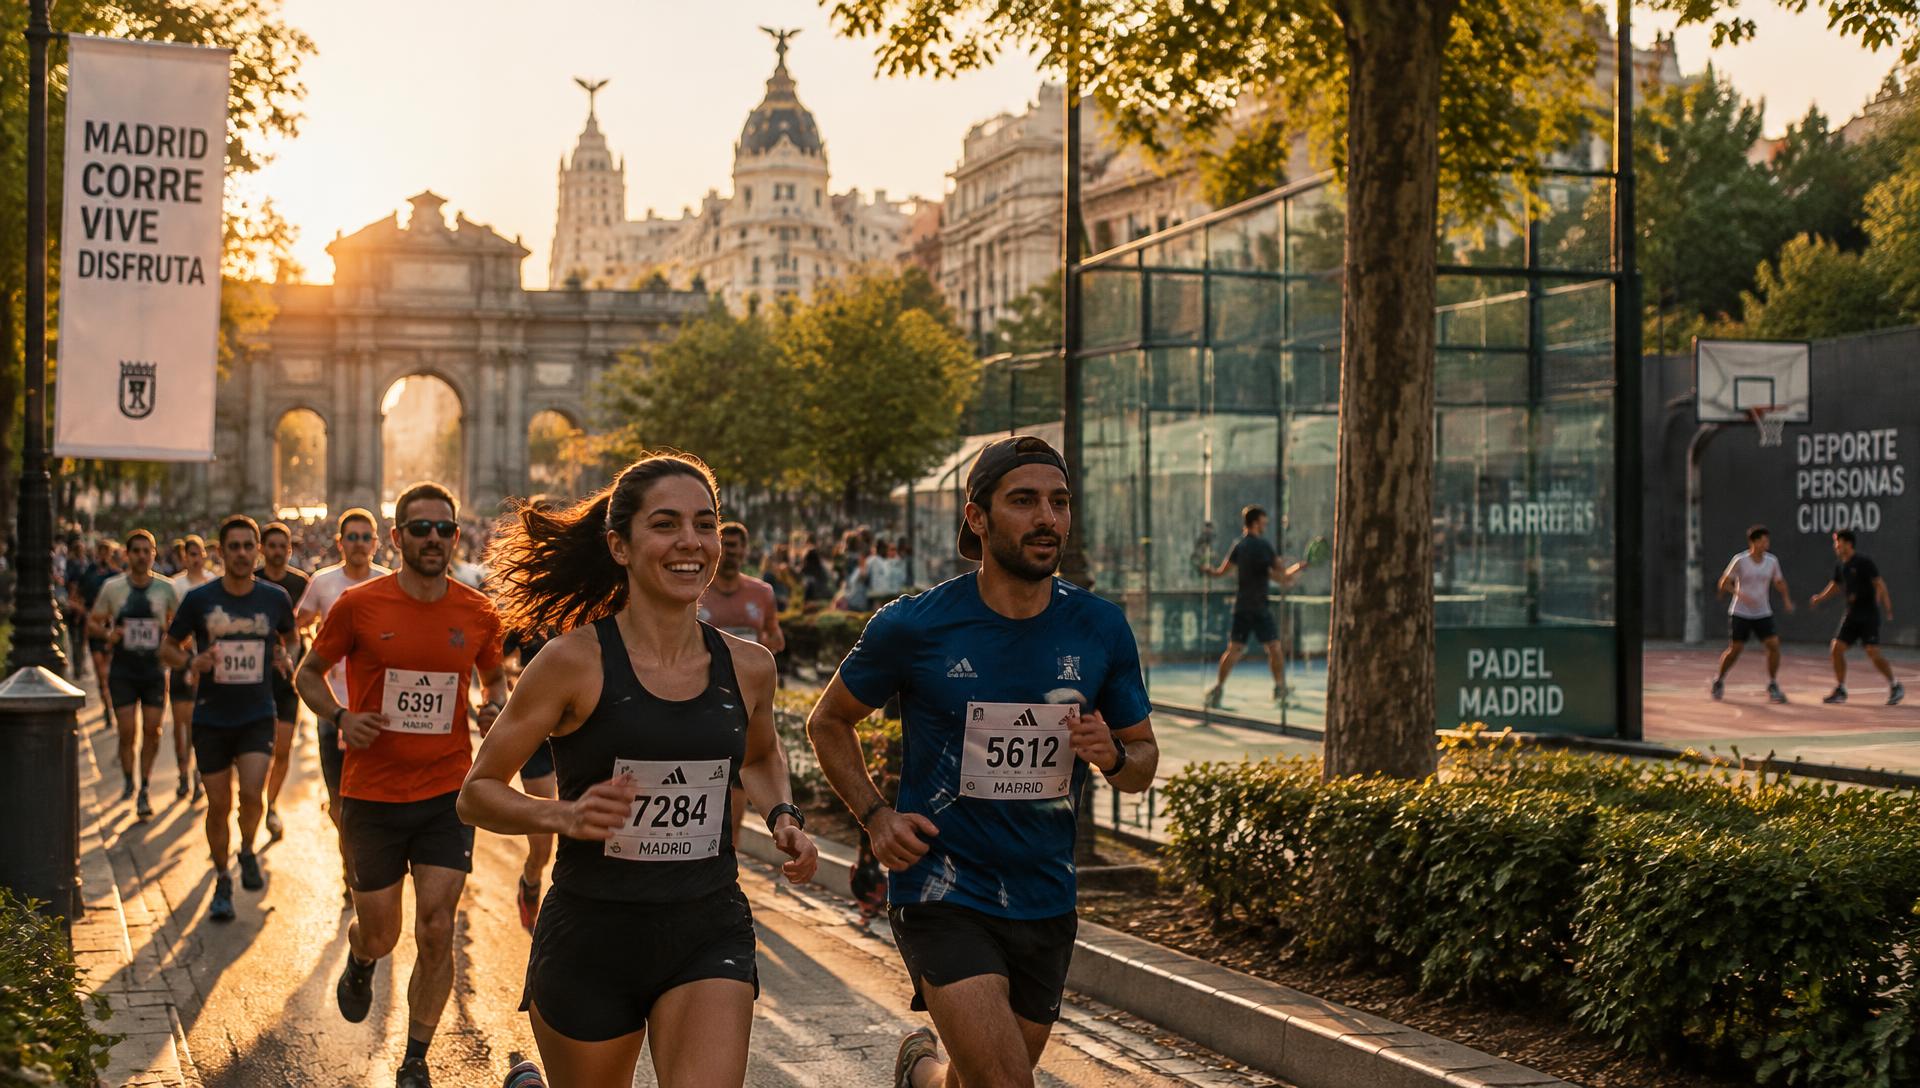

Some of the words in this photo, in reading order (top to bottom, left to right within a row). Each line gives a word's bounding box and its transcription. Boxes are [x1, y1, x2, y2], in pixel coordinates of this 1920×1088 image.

[84, 120, 208, 160] MADRID
[82, 162, 203, 203] CORRE
[81, 206, 158, 243] VIVE
[78, 250, 205, 285] DISFRUTA
[1797, 428, 1898, 465] DEPORTE
[1797, 465, 1904, 500] PERSONAS
[1797, 501, 1881, 533] CIUDAD
[224, 655, 256, 671] 9140
[1467, 647, 1552, 680] PADEL
[397, 691, 443, 714] 6391
[1458, 685, 1564, 717] MADRID
[986, 736, 1060, 769] 5612
[632, 794, 708, 828] 7284
[638, 841, 692, 855] MADRID
